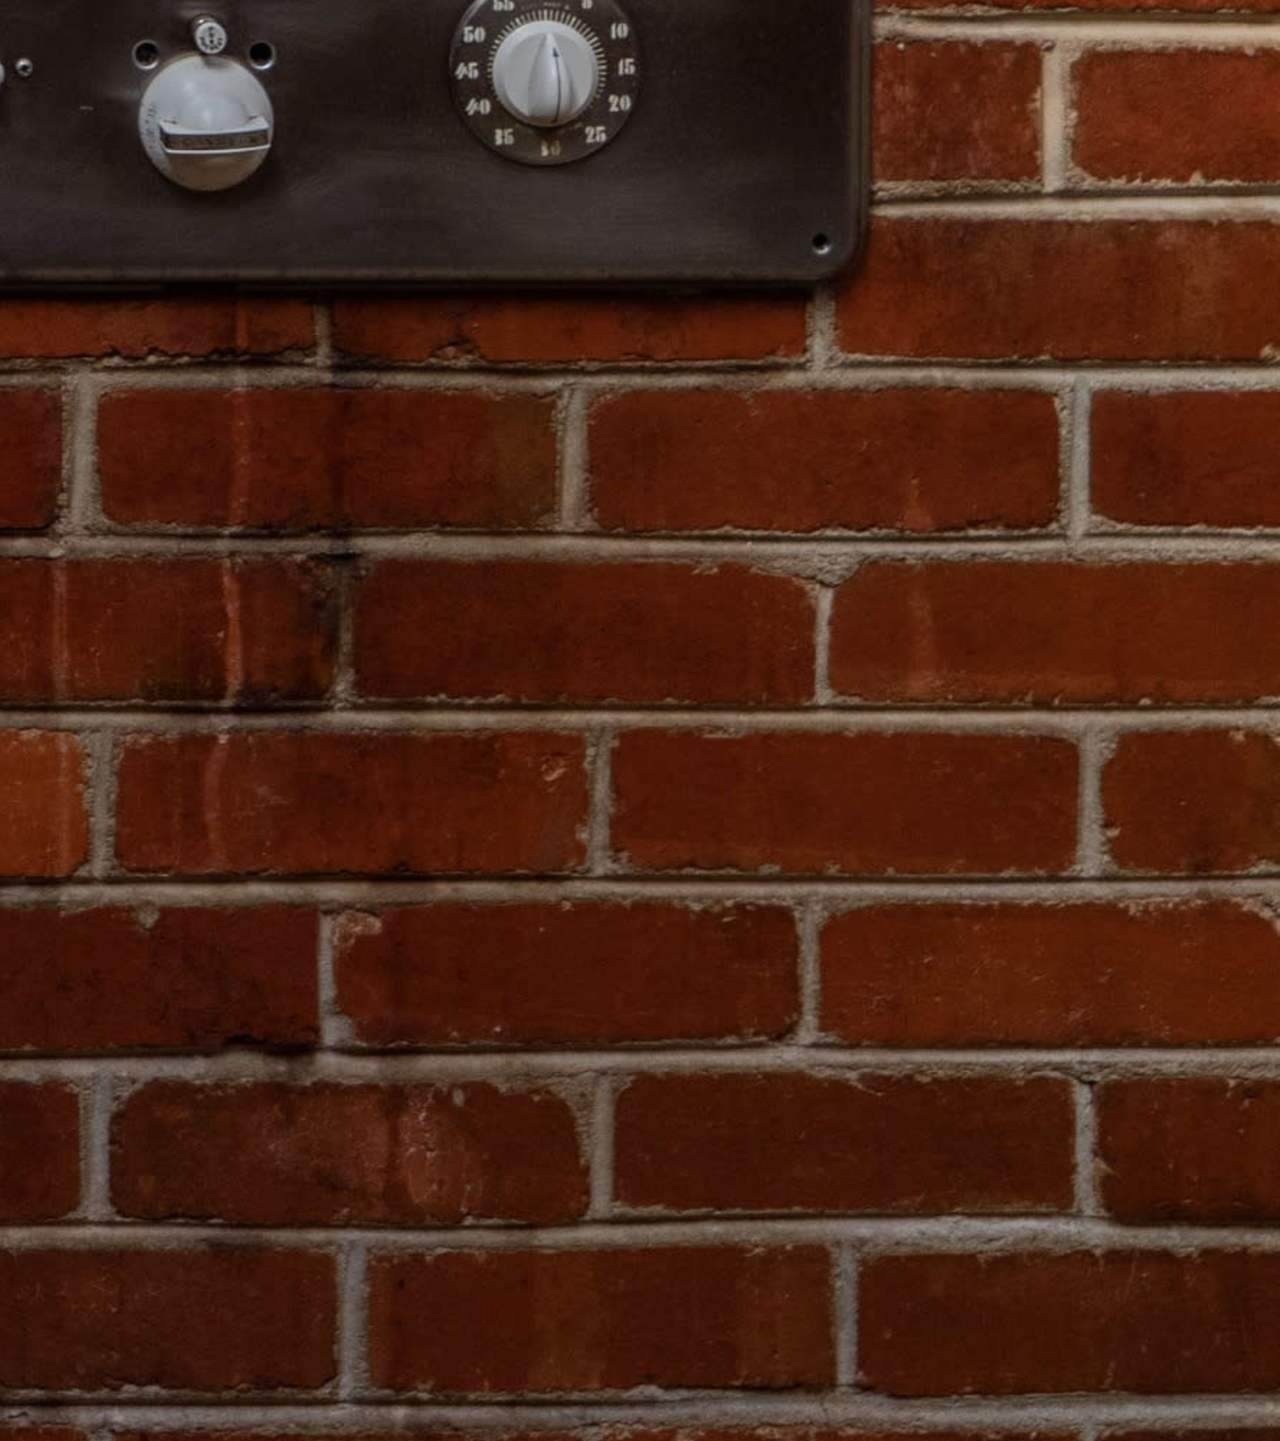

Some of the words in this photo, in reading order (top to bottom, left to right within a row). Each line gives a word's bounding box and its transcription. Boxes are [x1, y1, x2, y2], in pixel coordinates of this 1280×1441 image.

[463, 26, 486, 42] 50
[610, 23, 629, 39] 10
[455, 62, 479, 80] 45
[618, 59, 636, 76] 15
[465, 98, 491, 116] 40
[608, 95, 632, 112] 20
[585, 126, 607, 143] 25
